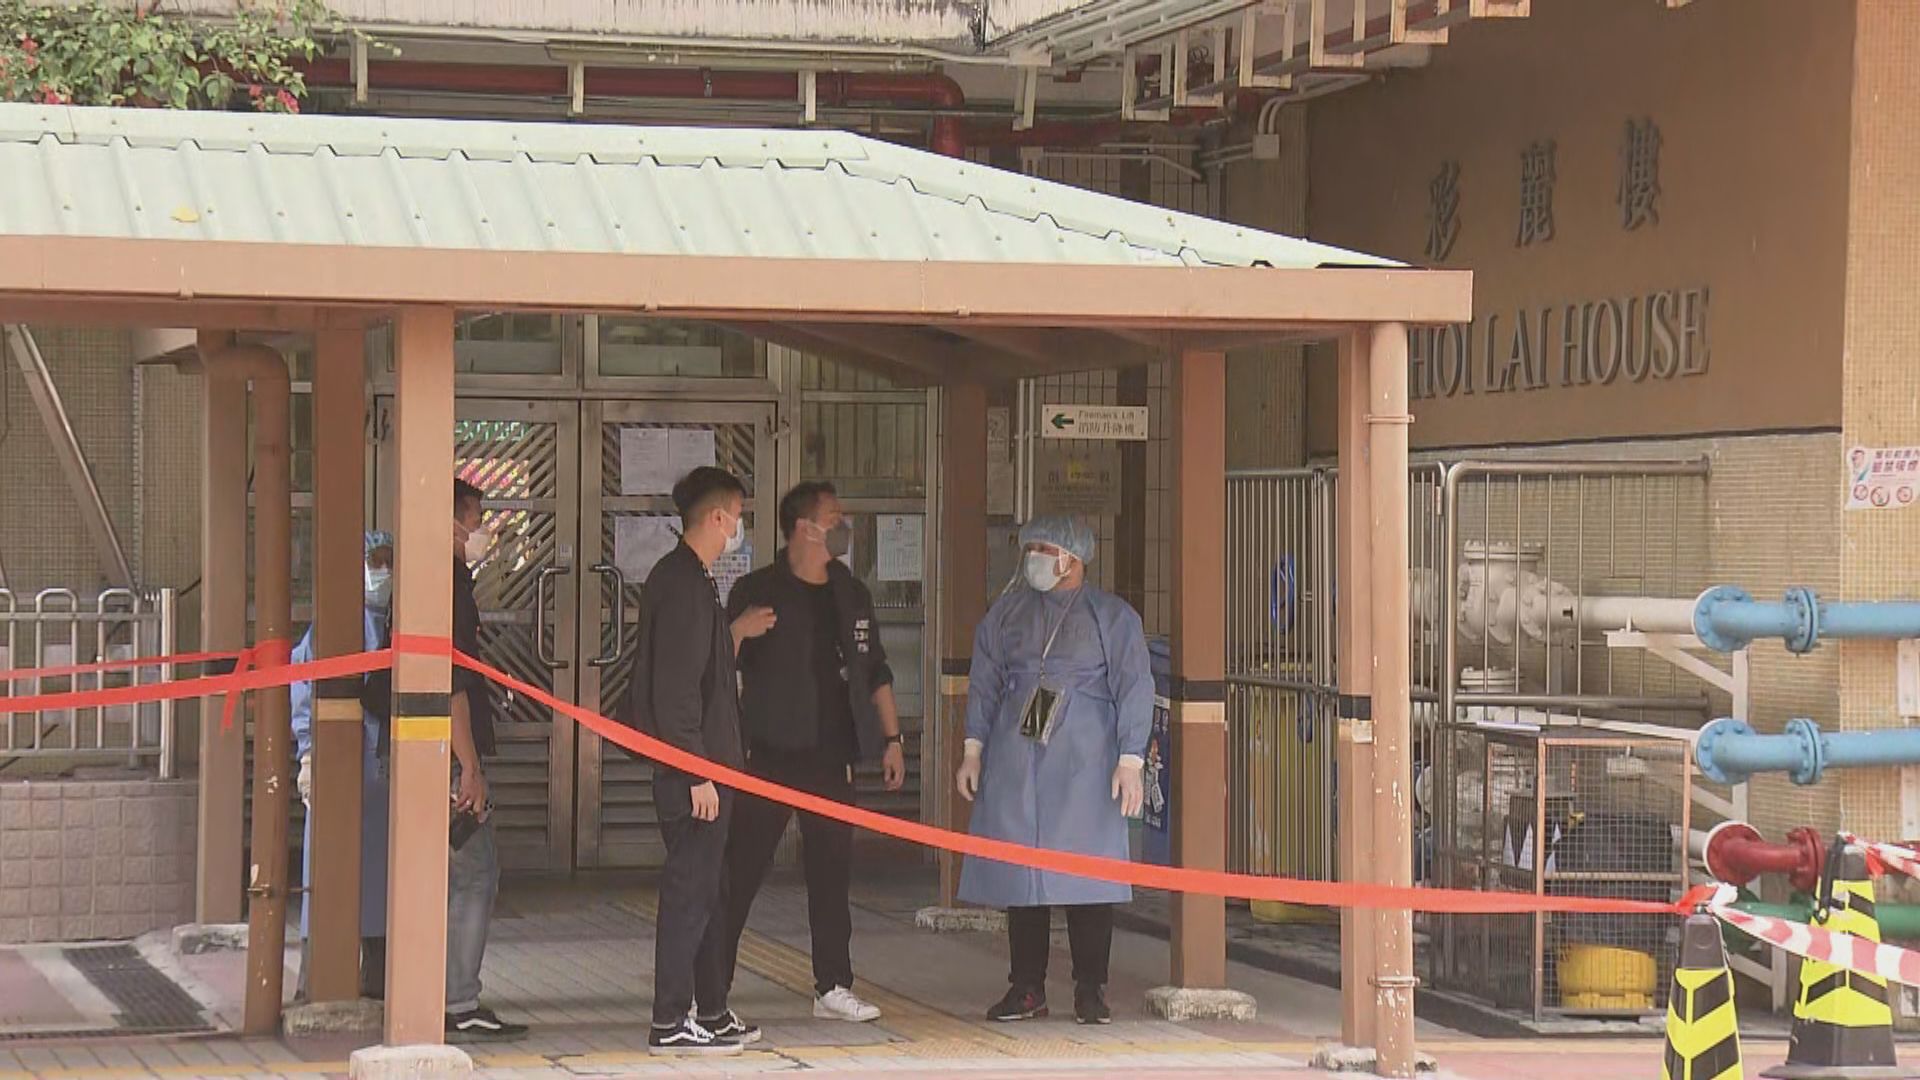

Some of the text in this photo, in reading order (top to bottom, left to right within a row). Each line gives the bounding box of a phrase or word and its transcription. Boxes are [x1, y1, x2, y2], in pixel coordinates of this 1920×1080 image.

[1425, 117, 1661, 262] 彩麗樓
[1408, 285, 1711, 399] HOI LAI HOUSE
